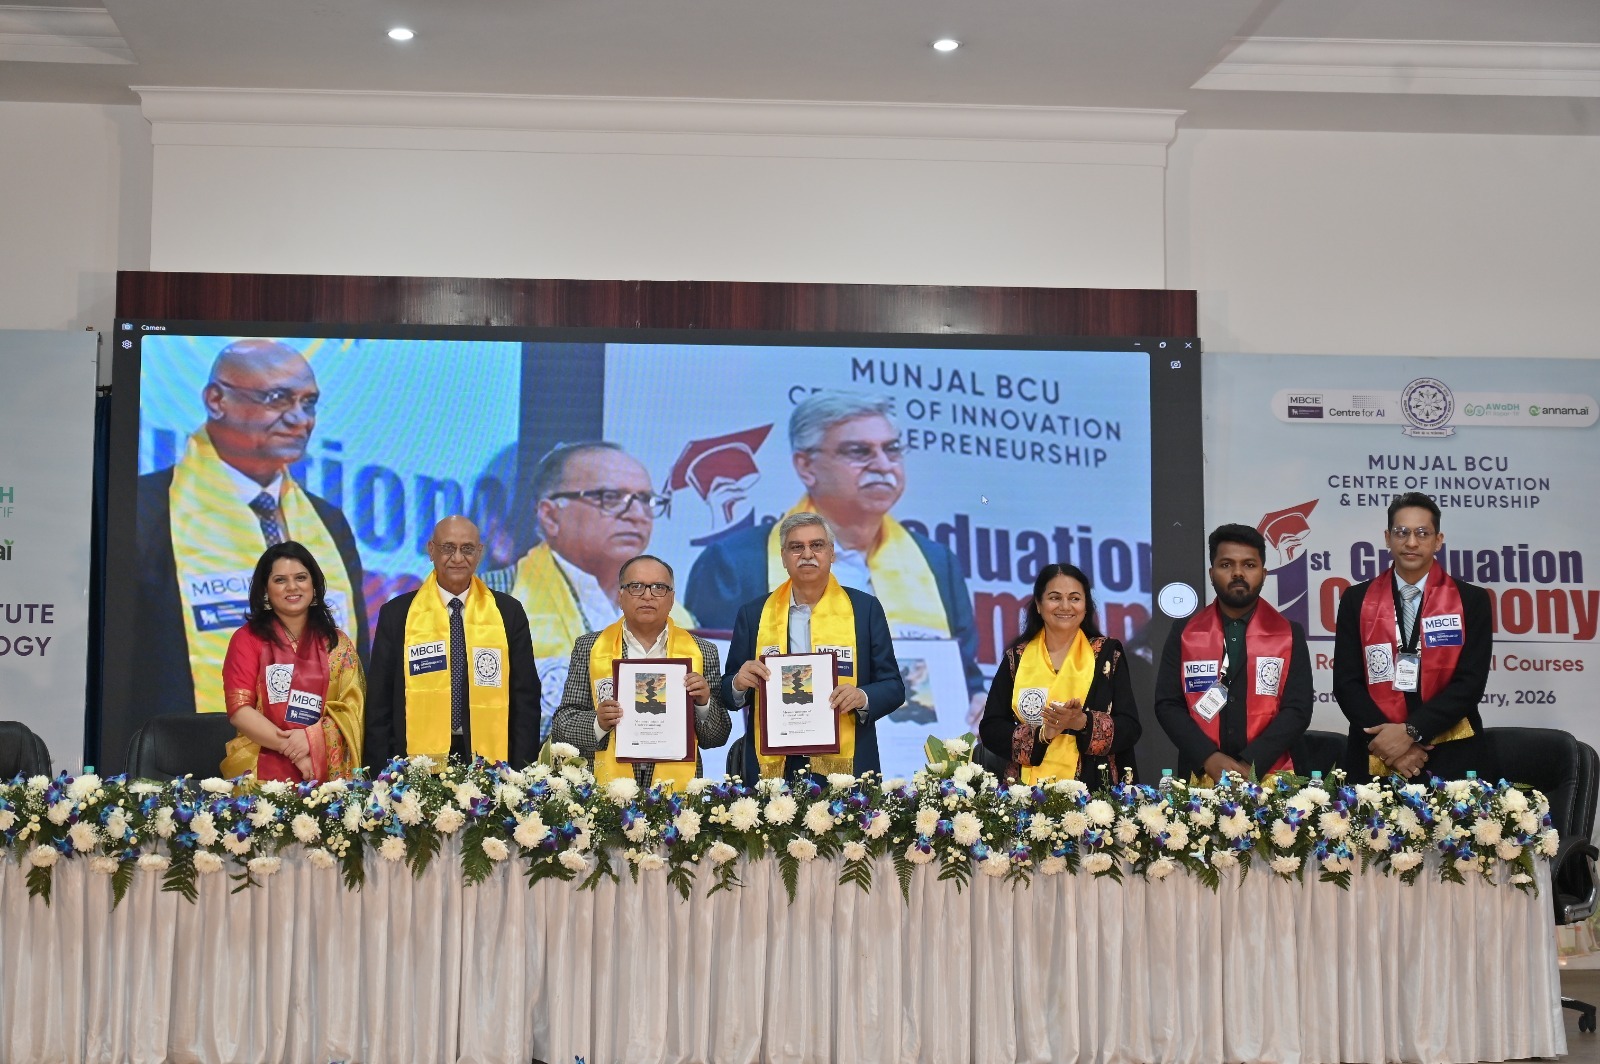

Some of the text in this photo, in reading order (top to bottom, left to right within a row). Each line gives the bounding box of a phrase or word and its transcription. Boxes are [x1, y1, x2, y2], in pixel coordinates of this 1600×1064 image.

[852, 357, 1059, 404] MUNJAL BCU
[1290, 396, 1321, 404] MBCIE
[1329, 408, 1361, 417] Centre
[1362, 408, 1374, 417] for
[1376, 409, 1385, 417] AI
[1542, 406, 1589, 416] annam.ai
[906, 399, 941, 421] OF
[952, 404, 1121, 441] INNOVATION
[899, 429, 1107, 468] EPRENEURSHIP
[1368, 454, 1509, 472] MUNJAL BCU
[1328, 475, 1550, 491] CENTRE OF INNOVATION
[1339, 493, 1541, 508] & ENTENEURSHIP
[1351, 541, 1583, 584] Gruation
[192, 577, 253, 597] MBCI
[0, 604, 54, 624] UTE
[1425, 617, 1460, 629] MBCIE
[410, 643, 444, 658] MBCIE
[1185, 663, 1216, 674] MBCIE
[1503, 654, 1585, 672] Courses
[291, 694, 323, 710] MBCIE
[1514, 690, 1557, 705] 2026
